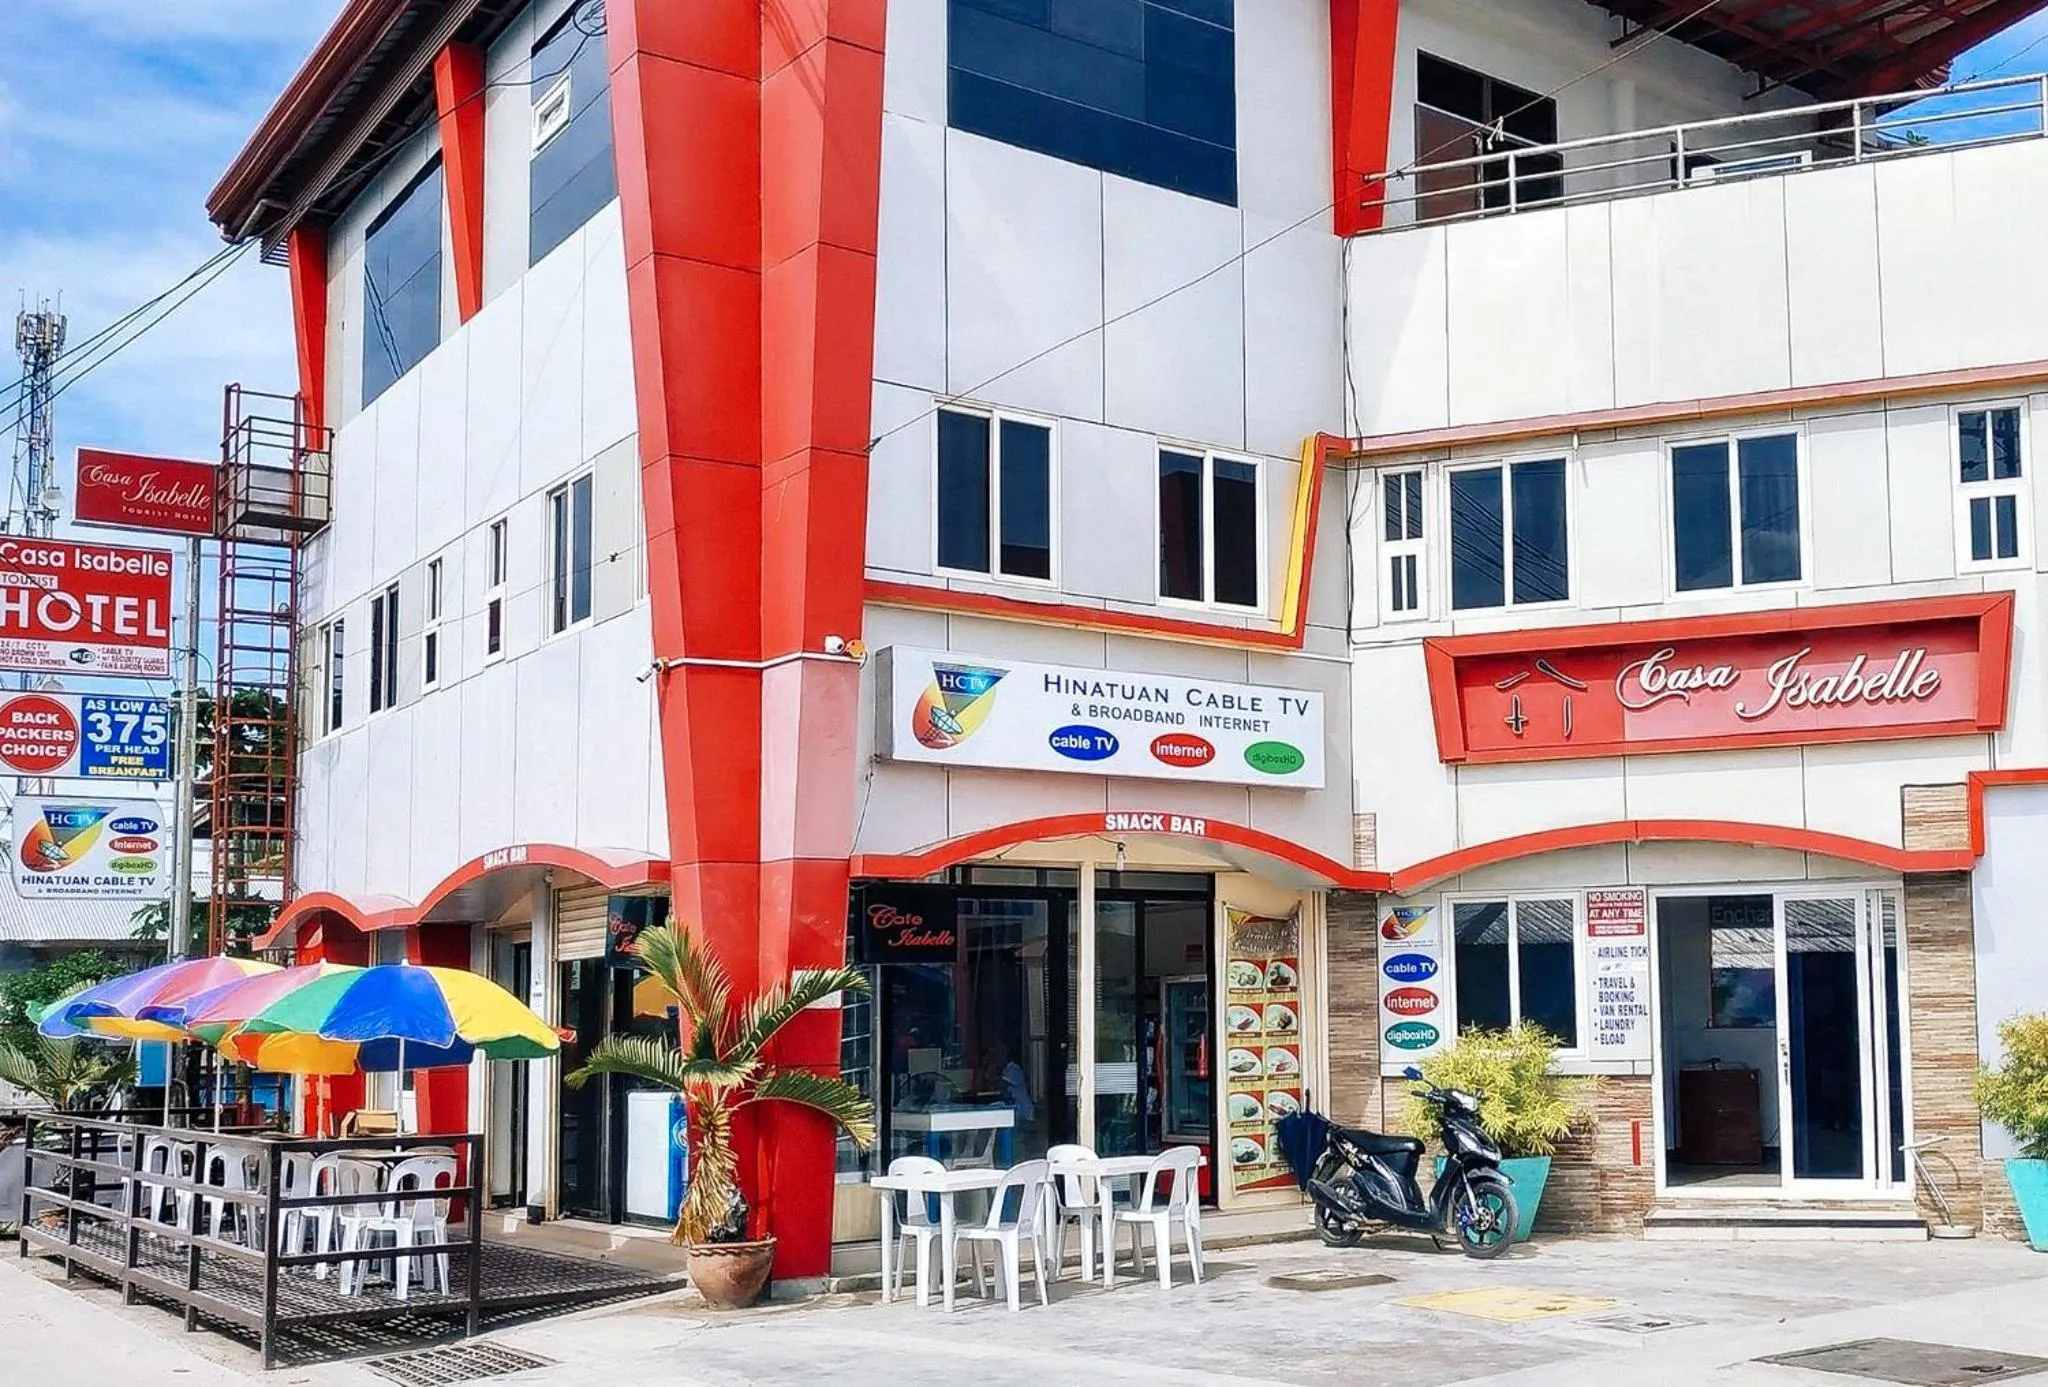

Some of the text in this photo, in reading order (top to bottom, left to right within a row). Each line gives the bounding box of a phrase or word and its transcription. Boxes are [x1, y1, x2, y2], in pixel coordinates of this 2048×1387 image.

[80, 464, 211, 509] Casa Isabelle
[0, 542, 169, 577] Casa Isabelle
[1, 574, 55, 587] TOURIST
[0, 588, 167, 637] HOTEL
[942, 673, 989, 690] HCTV
[1616, 647, 1943, 719] Casa Isabelle
[85, 700, 169, 714] AS LOW AS
[1186, 688, 1264, 713] CABLE
[1278, 697, 1310, 716] TV
[11, 711, 60, 725] BACK
[1071, 704, 1271, 734] & BROADBAND INTERNET
[0, 727, 75, 742] PACKERS
[87, 712, 166, 746] 375
[0, 743, 68, 757] CHOICE
[95, 744, 160, 755] PER HEAD
[1051, 735, 1115, 752] cable TV
[110, 755, 145, 766] FREE
[1252, 751, 1298, 766] digiboxHD
[88, 766, 166, 777] BREAKFAST
[50, 813, 97, 826] HCTV
[112, 821, 155, 831] cable TV
[1105, 813, 1206, 836] SNACK BAR
[22, 874, 155, 887] HINATUAN CABLE TV
[1589, 891, 1643, 902] NO SMOKING
[1590, 908, 1644, 919] AT ANY TIME
[1598, 946, 1628, 958] AIRLINE
[1386, 962, 1436, 973] cable TV
[1599, 976, 1628, 989] TRAVEL
[1598, 991, 1636, 1003] BOOKING
[1600, 1004, 1649, 1016] VAN RENTAL
[1600, 1018, 1635, 1031] LAUNDRY
[1386, 1029, 1436, 1043] digiboxHD
[1600, 1032, 1626, 1045] ELOAD
